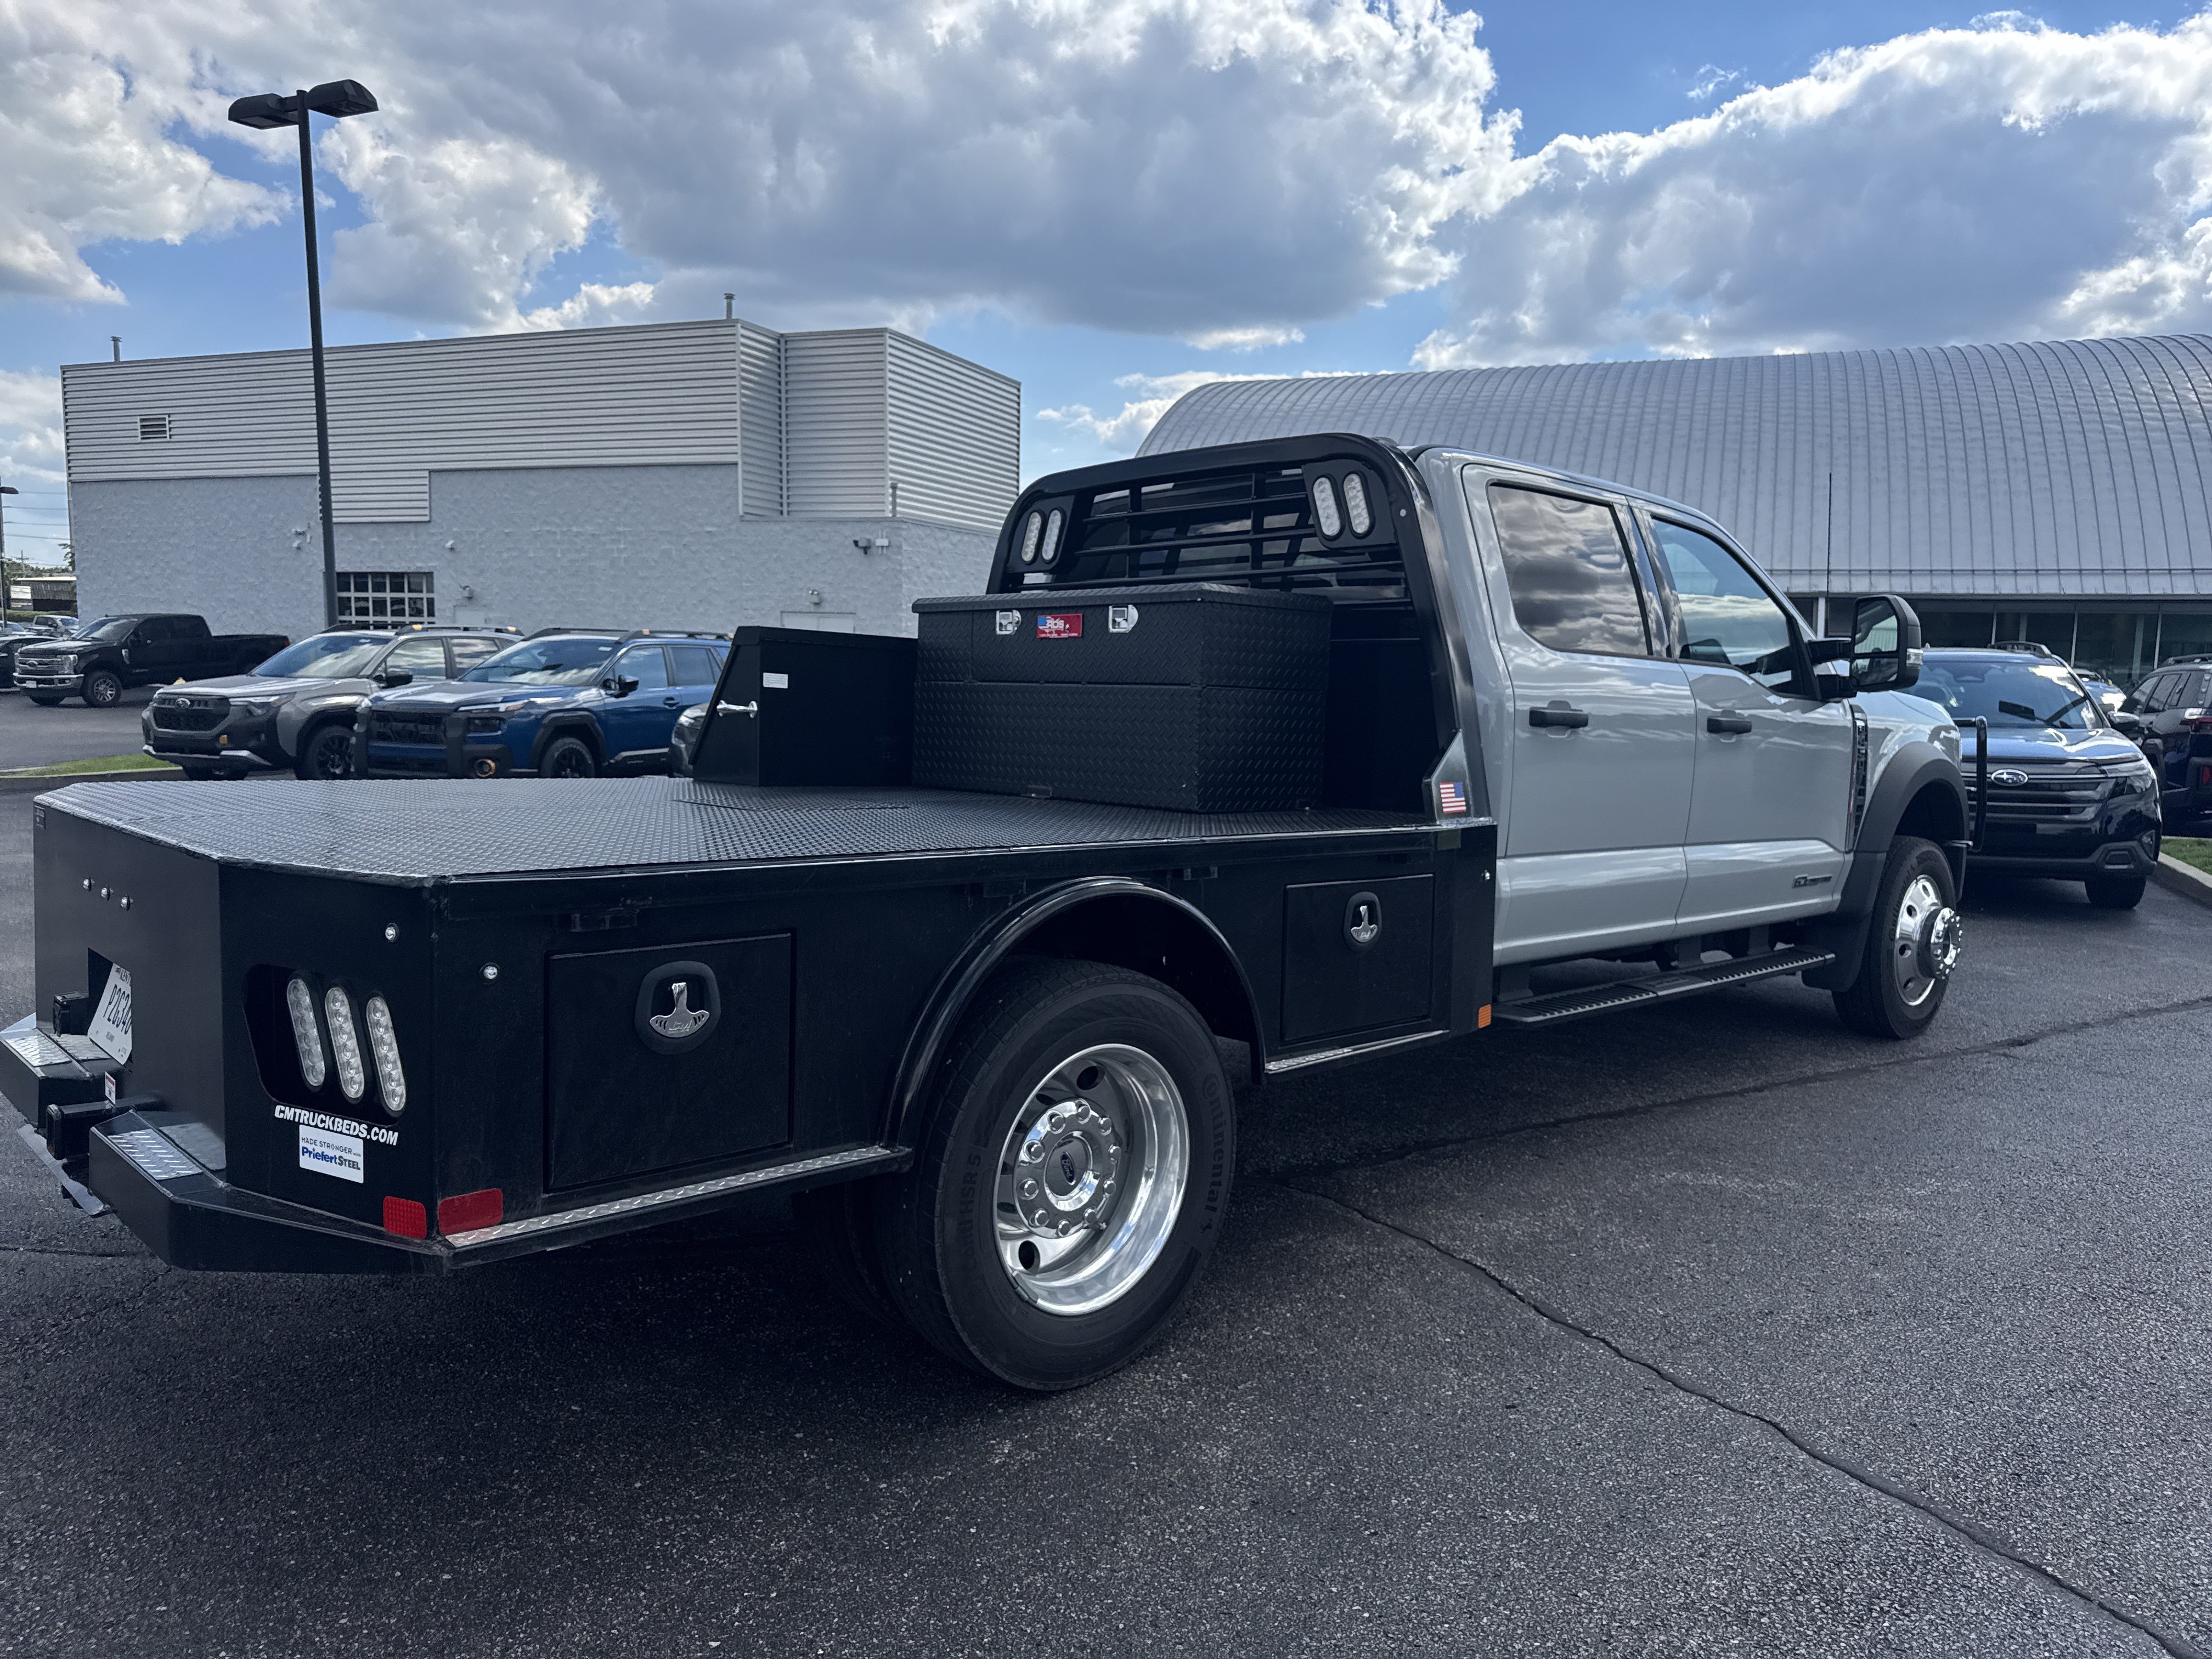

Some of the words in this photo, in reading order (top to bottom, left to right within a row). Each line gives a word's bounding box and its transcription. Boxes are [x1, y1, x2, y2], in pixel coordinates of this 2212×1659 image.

[274, 1105, 398, 1146] CMTRUCKBEDS.COM
[301, 1137, 318, 1147] MADE
[319, 1141, 352, 1154] STRONGER
[1203, 1073, 1225, 1213] Continental
[959, 1172, 977, 1214] HSR
[968, 1154, 981, 1167] 5
[1062, 1159, 1074, 1177] Ford
